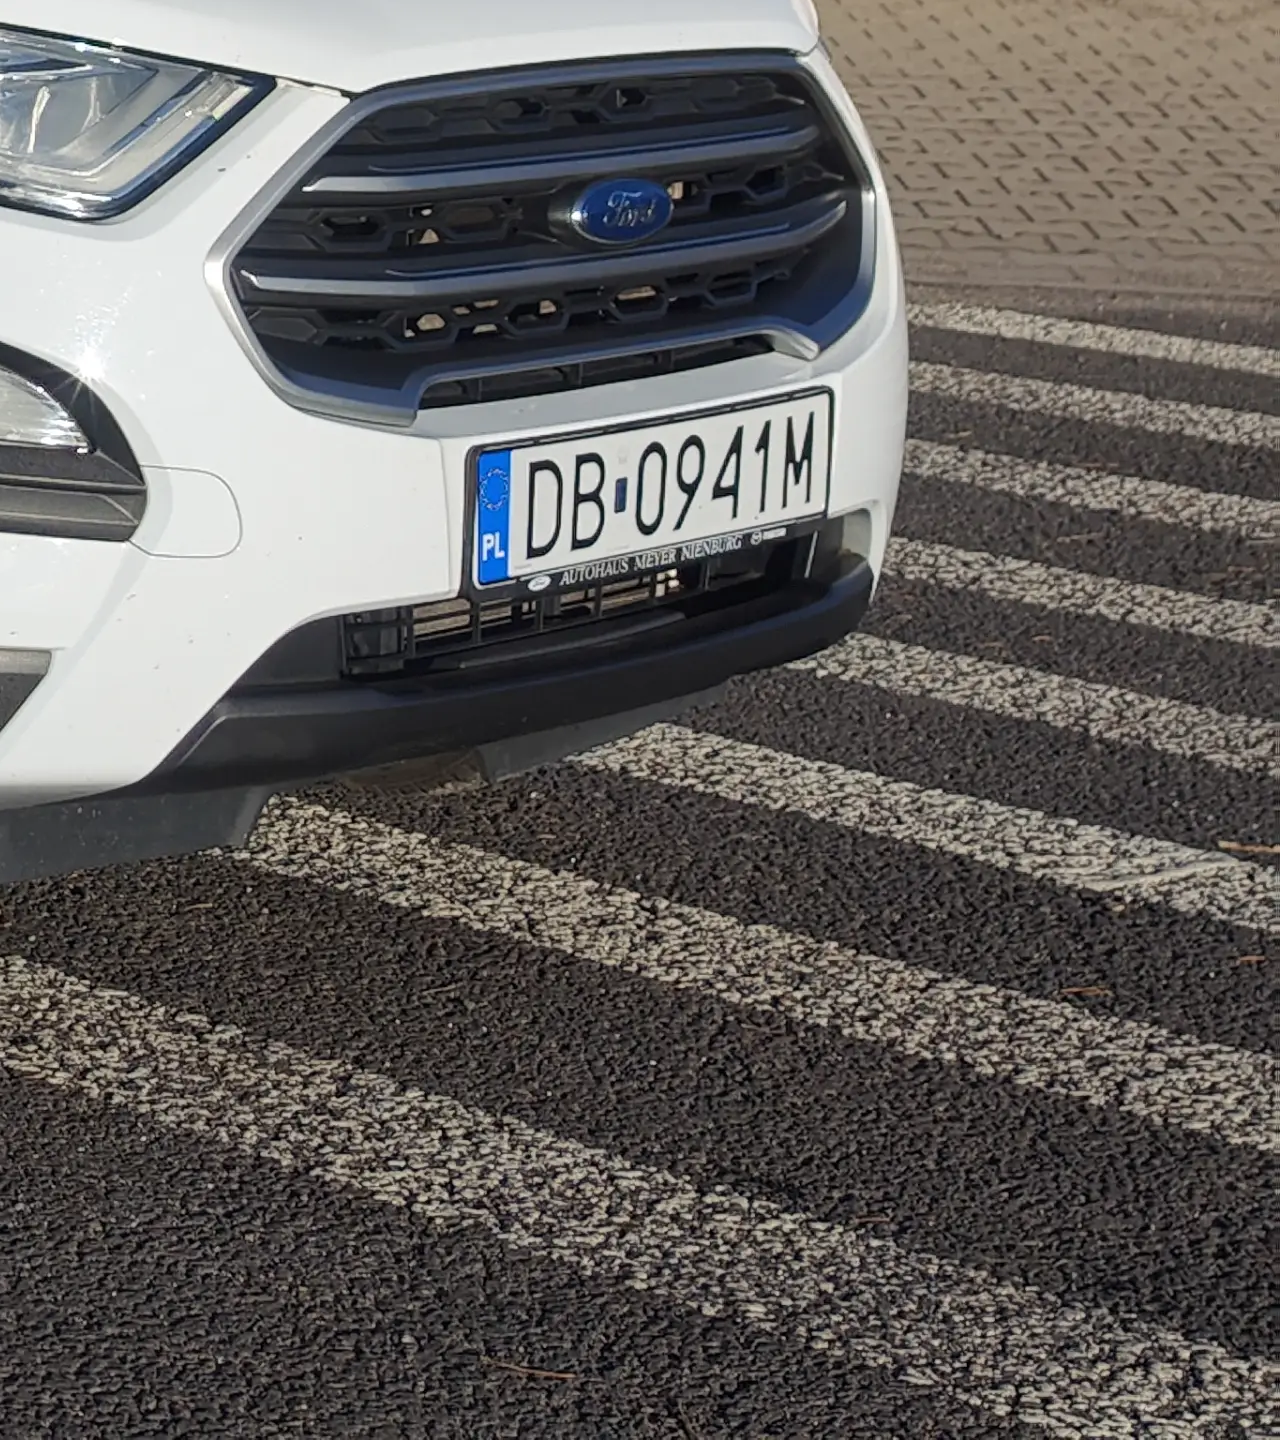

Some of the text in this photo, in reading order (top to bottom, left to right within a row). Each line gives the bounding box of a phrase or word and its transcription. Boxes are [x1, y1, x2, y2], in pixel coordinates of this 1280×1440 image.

[602, 190, 659, 228] Ford
[526, 410, 816, 560] DB 0941M
[482, 530, 506, 561] PL
[559, 558, 630, 586] AUTOHAUS
[633, 548, 678, 573] MEYER
[680, 534, 744, 561] NIENBURG
